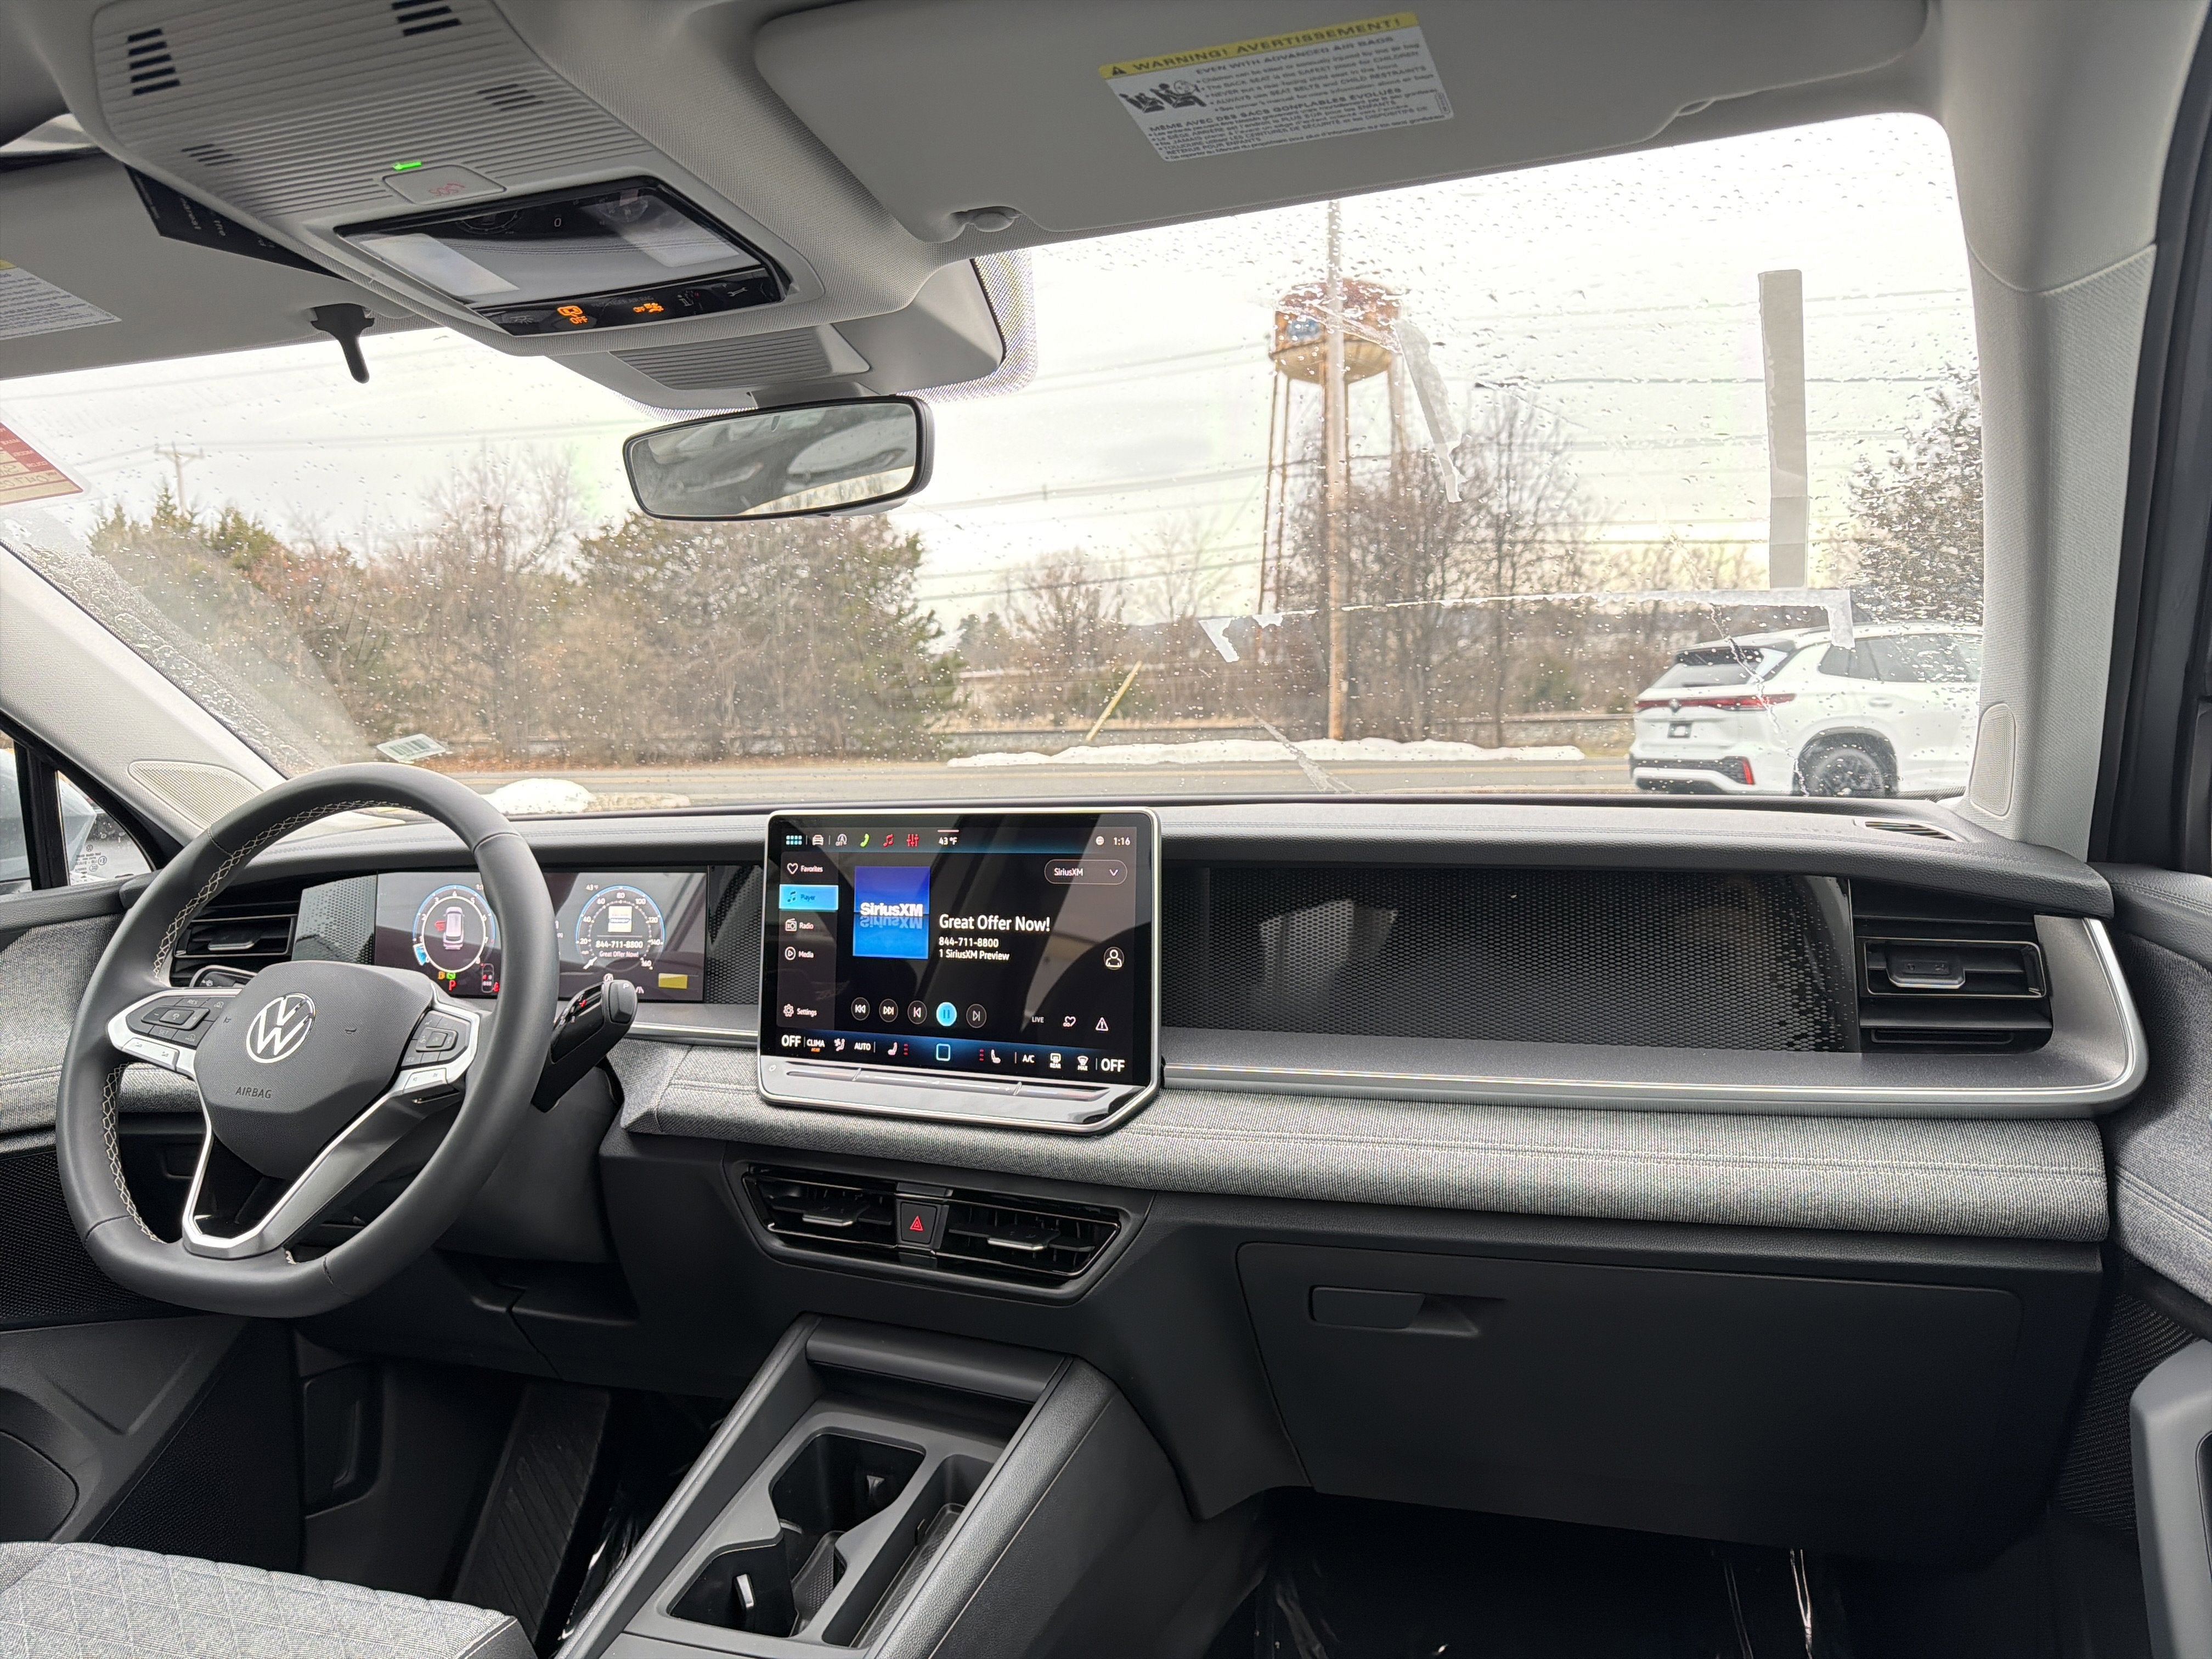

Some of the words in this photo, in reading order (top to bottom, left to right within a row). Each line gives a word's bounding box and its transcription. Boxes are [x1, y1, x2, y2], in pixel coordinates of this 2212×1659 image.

[1131, 48, 1229, 71] WARNING!
[1234, 19, 1401, 54] AVERTISSEMENT!
[569, 316, 588, 324] OFF
[1113, 837, 1131, 845] 1:16
[1054, 868, 1084, 876] SiriusXM
[860, 902, 923, 917] SiriusXM
[939, 913, 974, 929] Great
[977, 915, 1012, 930] Offer
[1015, 916, 1050, 932] Now!
[596, 940, 644, 949] 844-711-8800
[939, 937, 998, 947] 844-711-8800
[939, 949, 943, 958] 1
[945, 949, 978, 960] SiriusXM
[979, 950, 1010, 961] Preview
[797, 1008, 817, 1017] Settings
[781, 1034, 802, 1047] OFF
[806, 1039, 825, 1047] CLIMA
[854, 1042, 871, 1051] AUTO
[1022, 1054, 1035, 1063] A/C
[1101, 1058, 1125, 1072] OFF
[235, 1086, 272, 1099] AIRBAG
